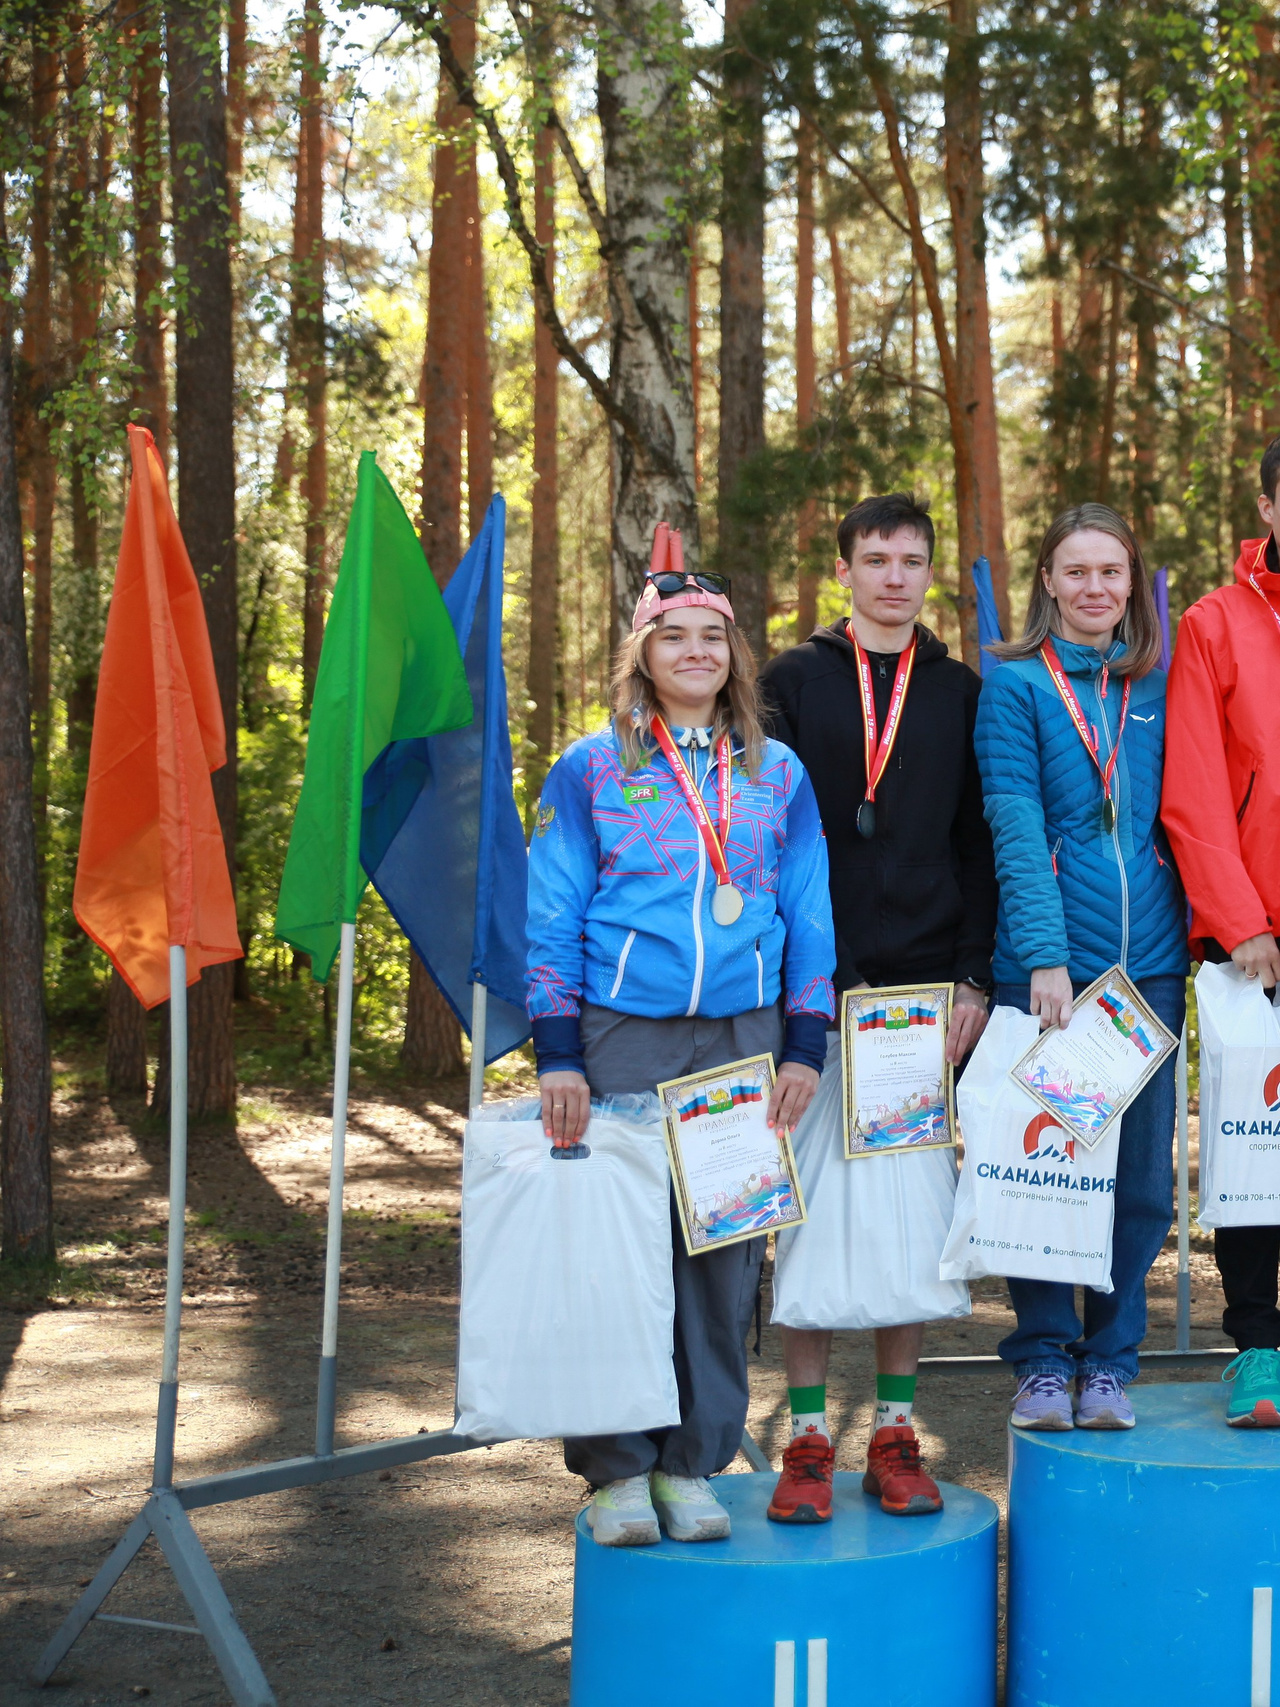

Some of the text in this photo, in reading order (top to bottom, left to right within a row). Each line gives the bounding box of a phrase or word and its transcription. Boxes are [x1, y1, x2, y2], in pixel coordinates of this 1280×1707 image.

[863, 682, 868, 691] да
[868, 718, 874, 726] 15
[1055, 671, 1066, 688] Иван
[1062, 689, 1070, 697] да
[1068, 698, 1080, 719] Марья
[891, 695, 900, 716] Марья
[890, 717, 895, 727] да
[883, 727, 892, 745] Иван
[670, 752, 679, 763] лет
[721, 756, 728, 764] 15
[630, 788, 651, 798] SFR
[681, 774, 694, 795] Марья
[692, 796, 701, 805] да
[723, 791, 729, 800] да
[697, 806, 707, 825] Иван
[873, 1033, 921, 1044] ГРАМОТА
[1092, 1016, 1133, 1055] ГРАМОТА
[697, 1111, 749, 1132] ГРАМОТА
[710, 1132, 740, 1145] Дорма Ольга
[977, 1163, 1115, 1192] СКАНДИНАВИЯ
[1001, 1188, 1088, 1206] спортивный магазин
[983, 1239, 995, 1247] 908
[997, 1241, 1033, 1251] 708-41-14
